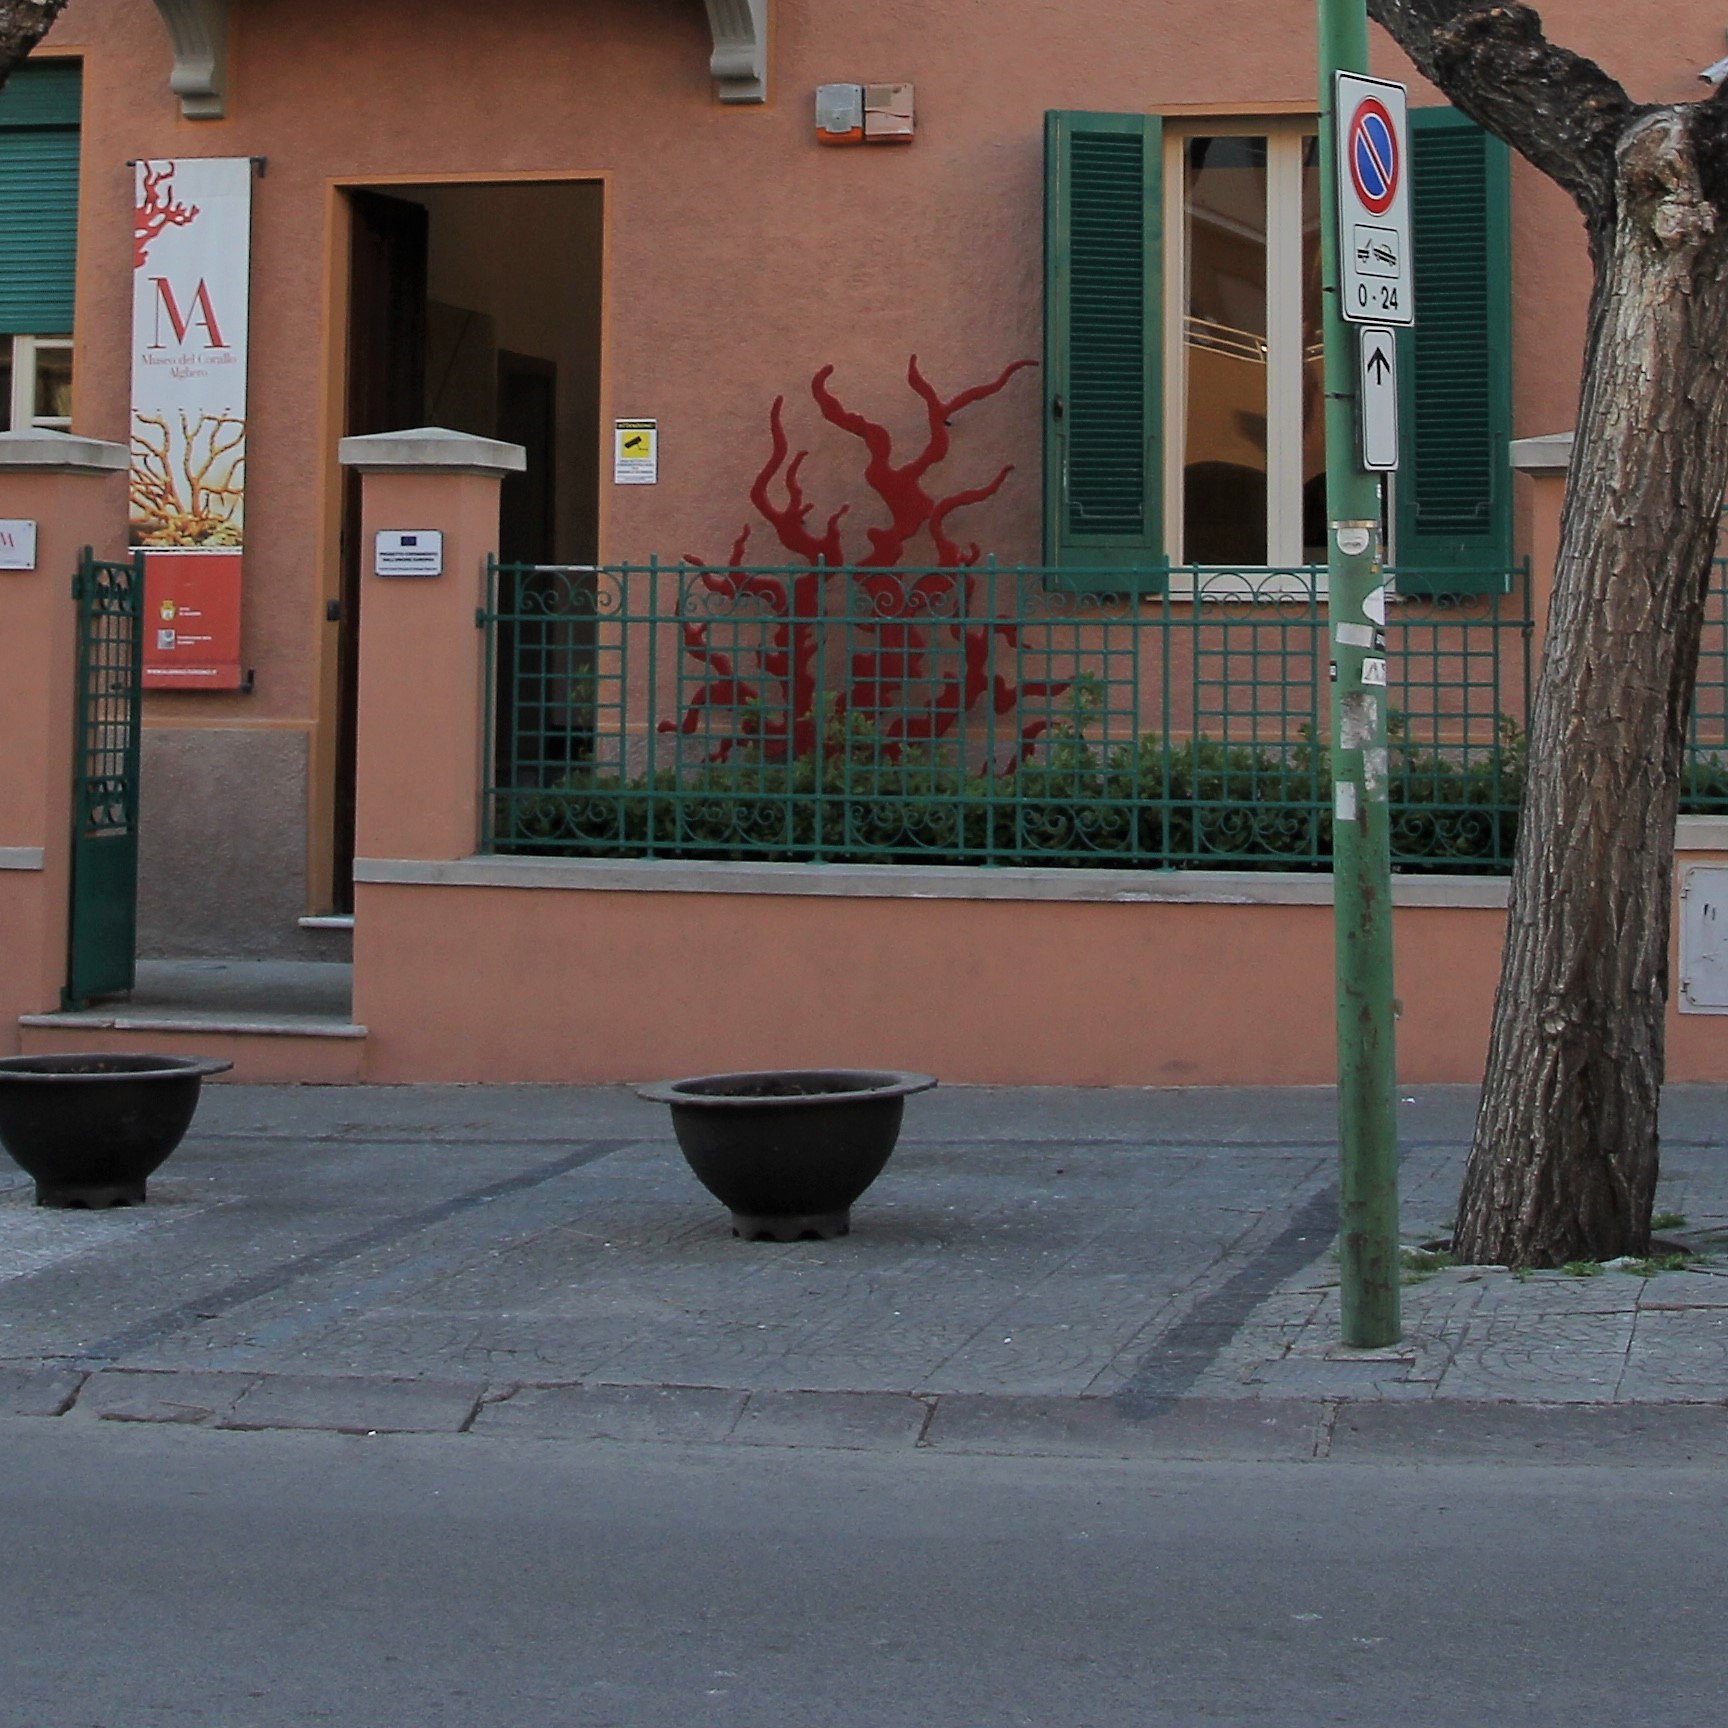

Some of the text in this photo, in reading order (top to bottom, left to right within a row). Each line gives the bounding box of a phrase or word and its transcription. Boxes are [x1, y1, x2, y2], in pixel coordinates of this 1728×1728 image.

[1358, 283, 1368, 307] 0
[1381, 285, 1398, 310] 24
[142, 353, 236, 365] Museo del Corallo
[170, 367, 208, 379] Alghero
